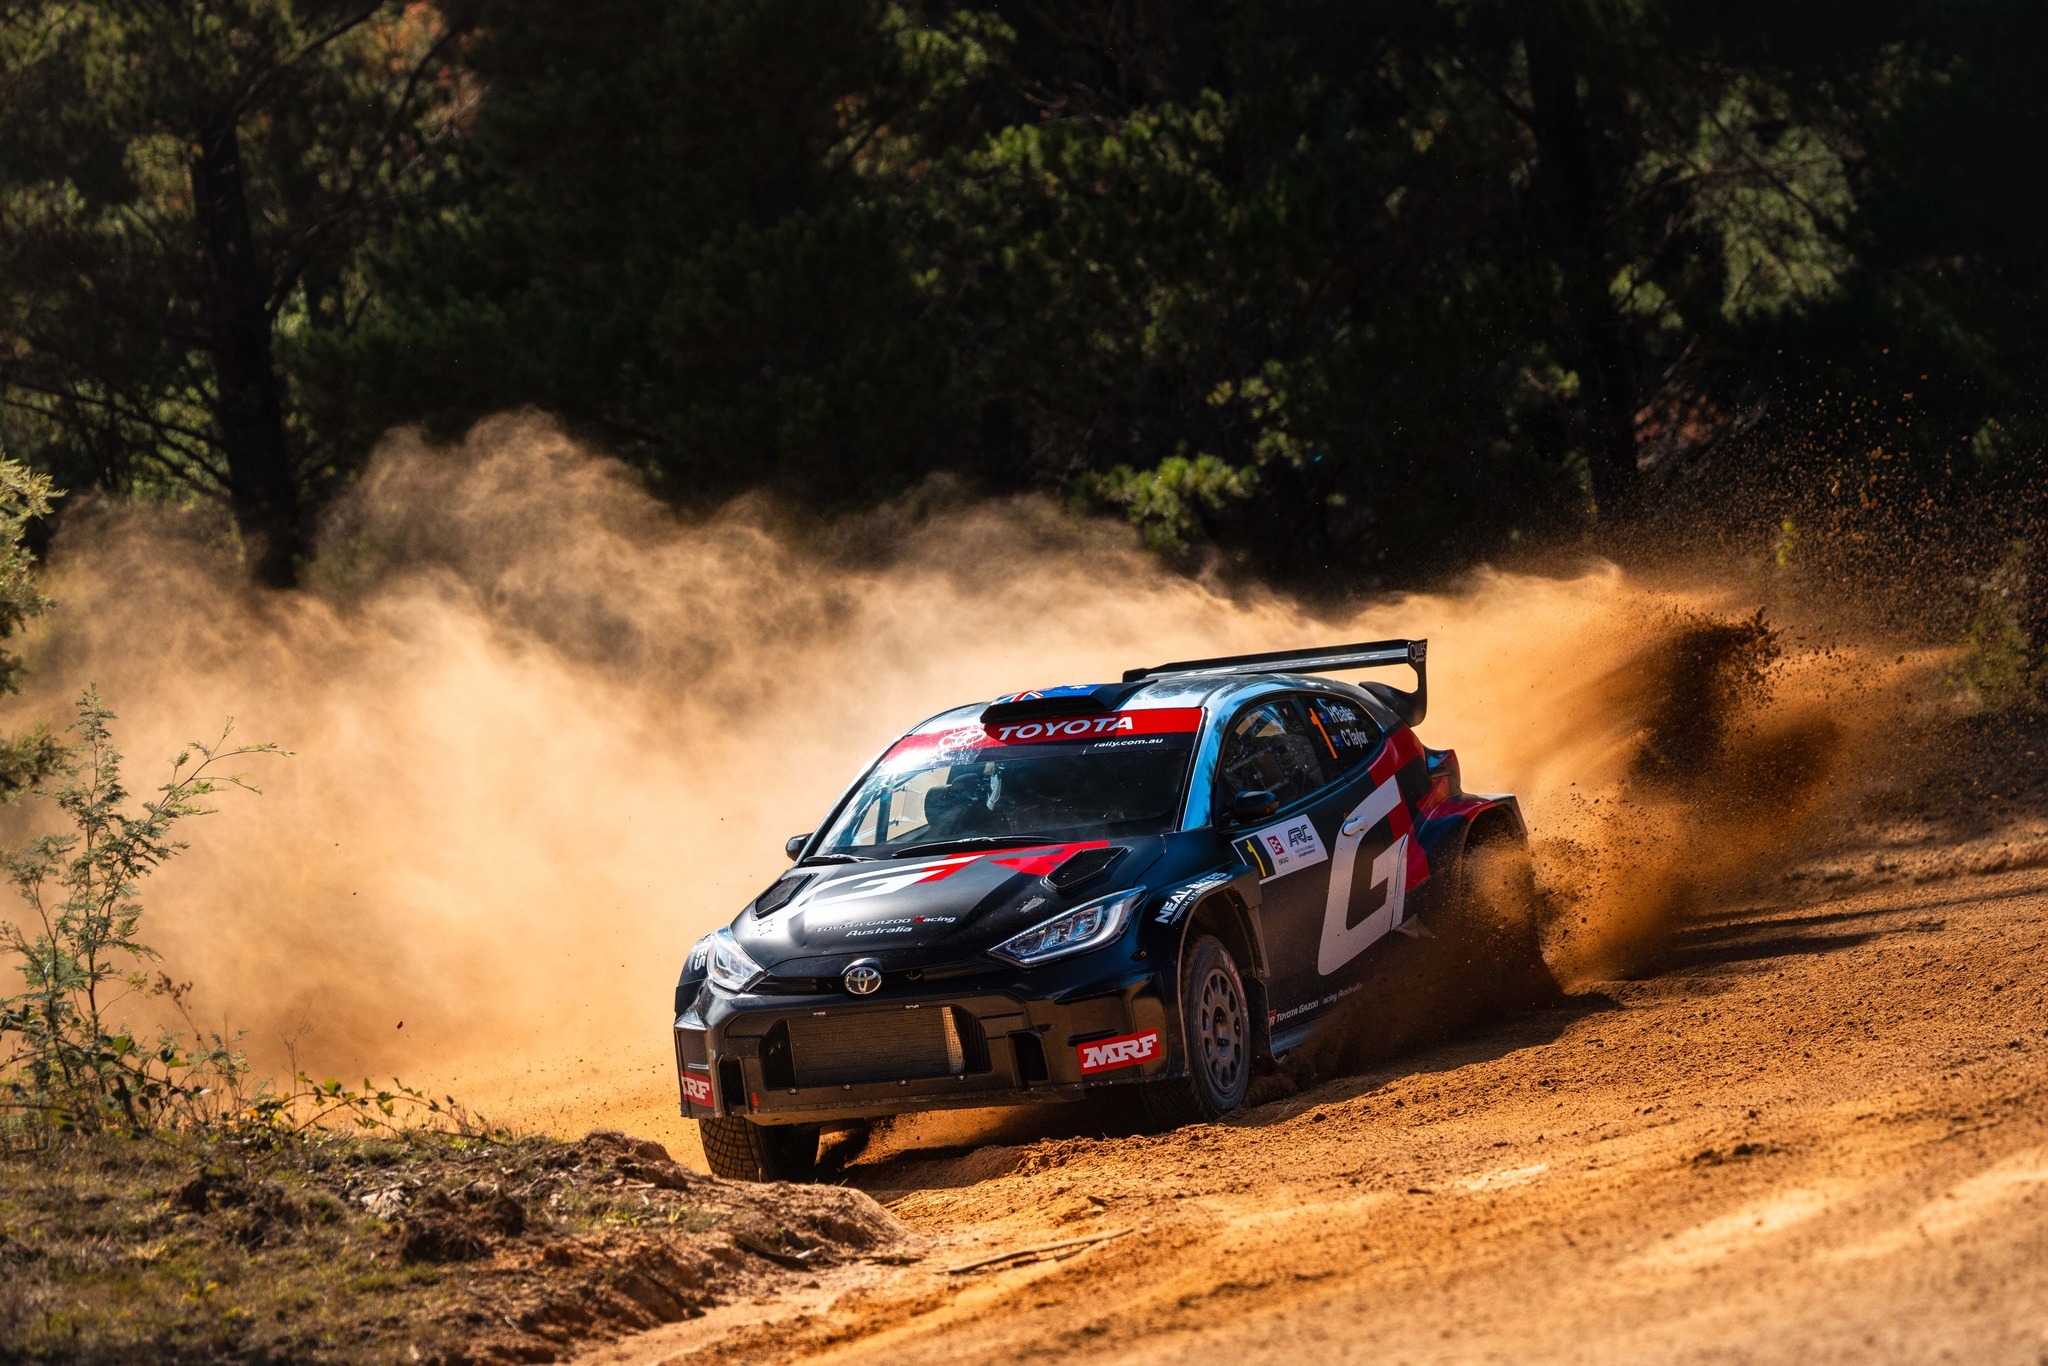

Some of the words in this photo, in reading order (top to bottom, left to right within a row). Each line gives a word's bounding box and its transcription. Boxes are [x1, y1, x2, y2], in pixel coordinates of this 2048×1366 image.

[998, 716, 1134, 741] TOYOTA
[1309, 707, 1338, 759] 1
[1340, 729, 1351, 747] C
[1094, 738, 1164, 749] rally.com.au
[1246, 839, 1267, 877] 1
[1154, 889, 1193, 924] NEAL
[815, 921, 863, 933] TOYOTA
[866, 916, 911, 927] GAZOO
[845, 925, 913, 938] Australia
[1083, 1033, 1158, 1069] MRF
